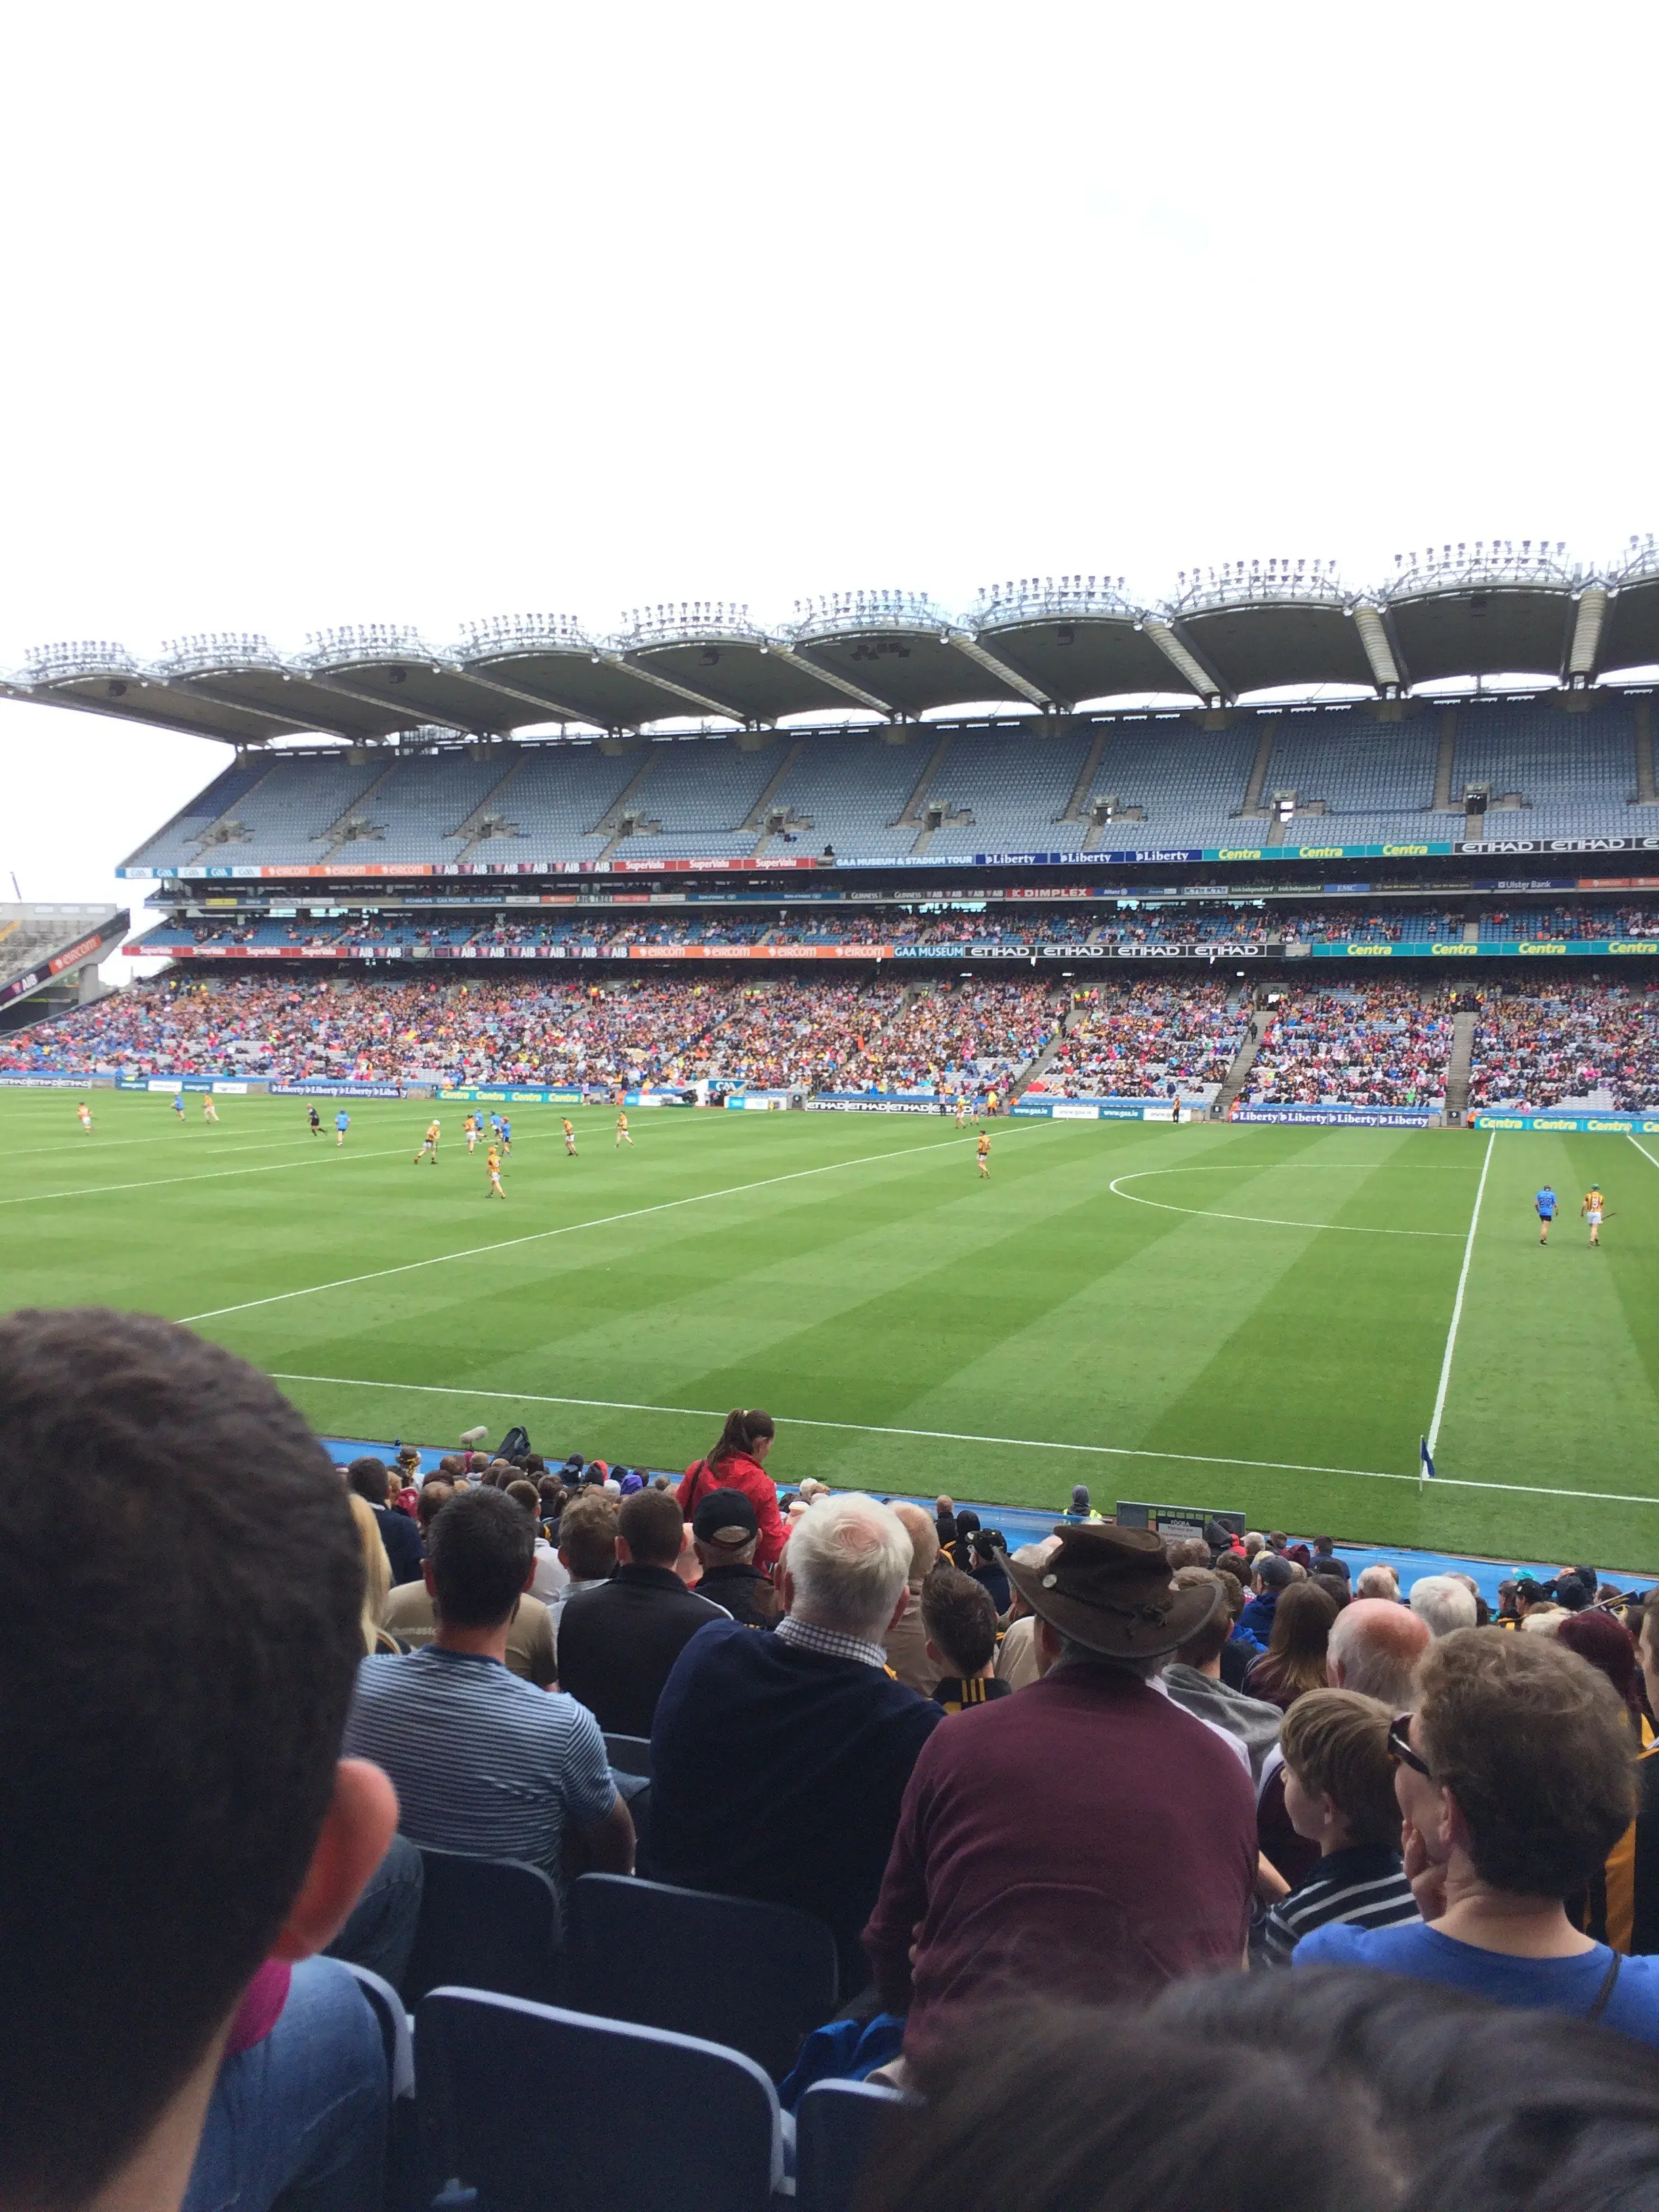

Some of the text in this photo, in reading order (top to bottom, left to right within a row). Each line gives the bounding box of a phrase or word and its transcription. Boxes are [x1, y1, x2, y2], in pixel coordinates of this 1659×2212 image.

[1382, 844, 1429, 855] Centra
[1462, 841, 1534, 853] ETIHAD
[1551, 839, 1625, 851] ETIHAD
[1144, 851, 1189, 861] Liberty
[1218, 848, 1261, 860] Centra
[1299, 846, 1343, 858] Centra
[857, 857, 895, 865] MUSEUM
[896, 857, 905, 865] &
[905, 857, 945, 865] STADIUM
[947, 856, 973, 864] TOUR
[993, 854, 1036, 865] Liberty
[1068, 853, 1111, 863] Liberty
[472, 864, 487, 874] AIB
[504, 864, 518, 874] AIB
[533, 863, 548, 874] AIB
[565, 863, 580, 873] AIB
[595, 862, 610, 872] AIB
[626, 861, 665, 872] SuperValu
[689, 860, 729, 870] SuperValu
[756, 859, 797, 869] SuperValu
[444, 865, 459, 875] AIB
[1024, 888, 1088, 898] DIMPLEX
[63, 938, 98, 965] eircom
[359, 947, 373, 958] AIB
[387, 947, 402, 958] AIB
[462, 947, 476, 958] AIB
[489, 947, 505, 958] AIB
[520, 947, 536, 958] AIB
[550, 947, 565, 958] AIB
[581, 947, 597, 958] AIB
[611, 947, 627, 958] AIB
[648, 947, 686, 958] eircom
[712, 947, 750, 957] eircom
[777, 947, 817, 957] eircom
[845, 947, 884, 957] eircom
[895, 947, 964, 957] GAA MUSEUM
[970, 947, 1030, 956] ETIHAD
[1044, 947, 1103, 956] ETIHAD
[1118, 946, 1180, 956] ETIHAD
[1194, 946, 1258, 955] ETIHAD
[1347, 944, 1393, 955] Centra
[1431, 943, 1478, 955] Centra
[1519, 943, 1567, 954] Centra
[1609, 942, 1658, 954] Centra
[278, 1086, 304, 1095] Liberty
[311, 1086, 339, 1097] Liberty
[345, 1087, 373, 1097] Liberty
[441, 1090, 470, 1099] Centra
[476, 1090, 506, 1101] Centra
[512, 1091, 542, 1101] Centra
[548, 1092, 579, 1103] Centra
[807, 1101, 846, 1110] ETIHAD
[848, 1102, 887, 1111] ETIHAD
[890, 1103, 928, 1112] ETIHAD
[1103, 1110, 1139, 1118] www.gaa.ie
[1240, 1111, 1279, 1123] Liberty
[1288, 1113, 1328, 1125] Liberty
[1337, 1114, 1377, 1126] Liberty
[1388, 1115, 1429, 1128] Liberty
[1479, 1118, 1523, 1128] Centra
[1533, 1119, 1577, 1130] Centra
[1588, 1120, 1632, 1131] Centra
